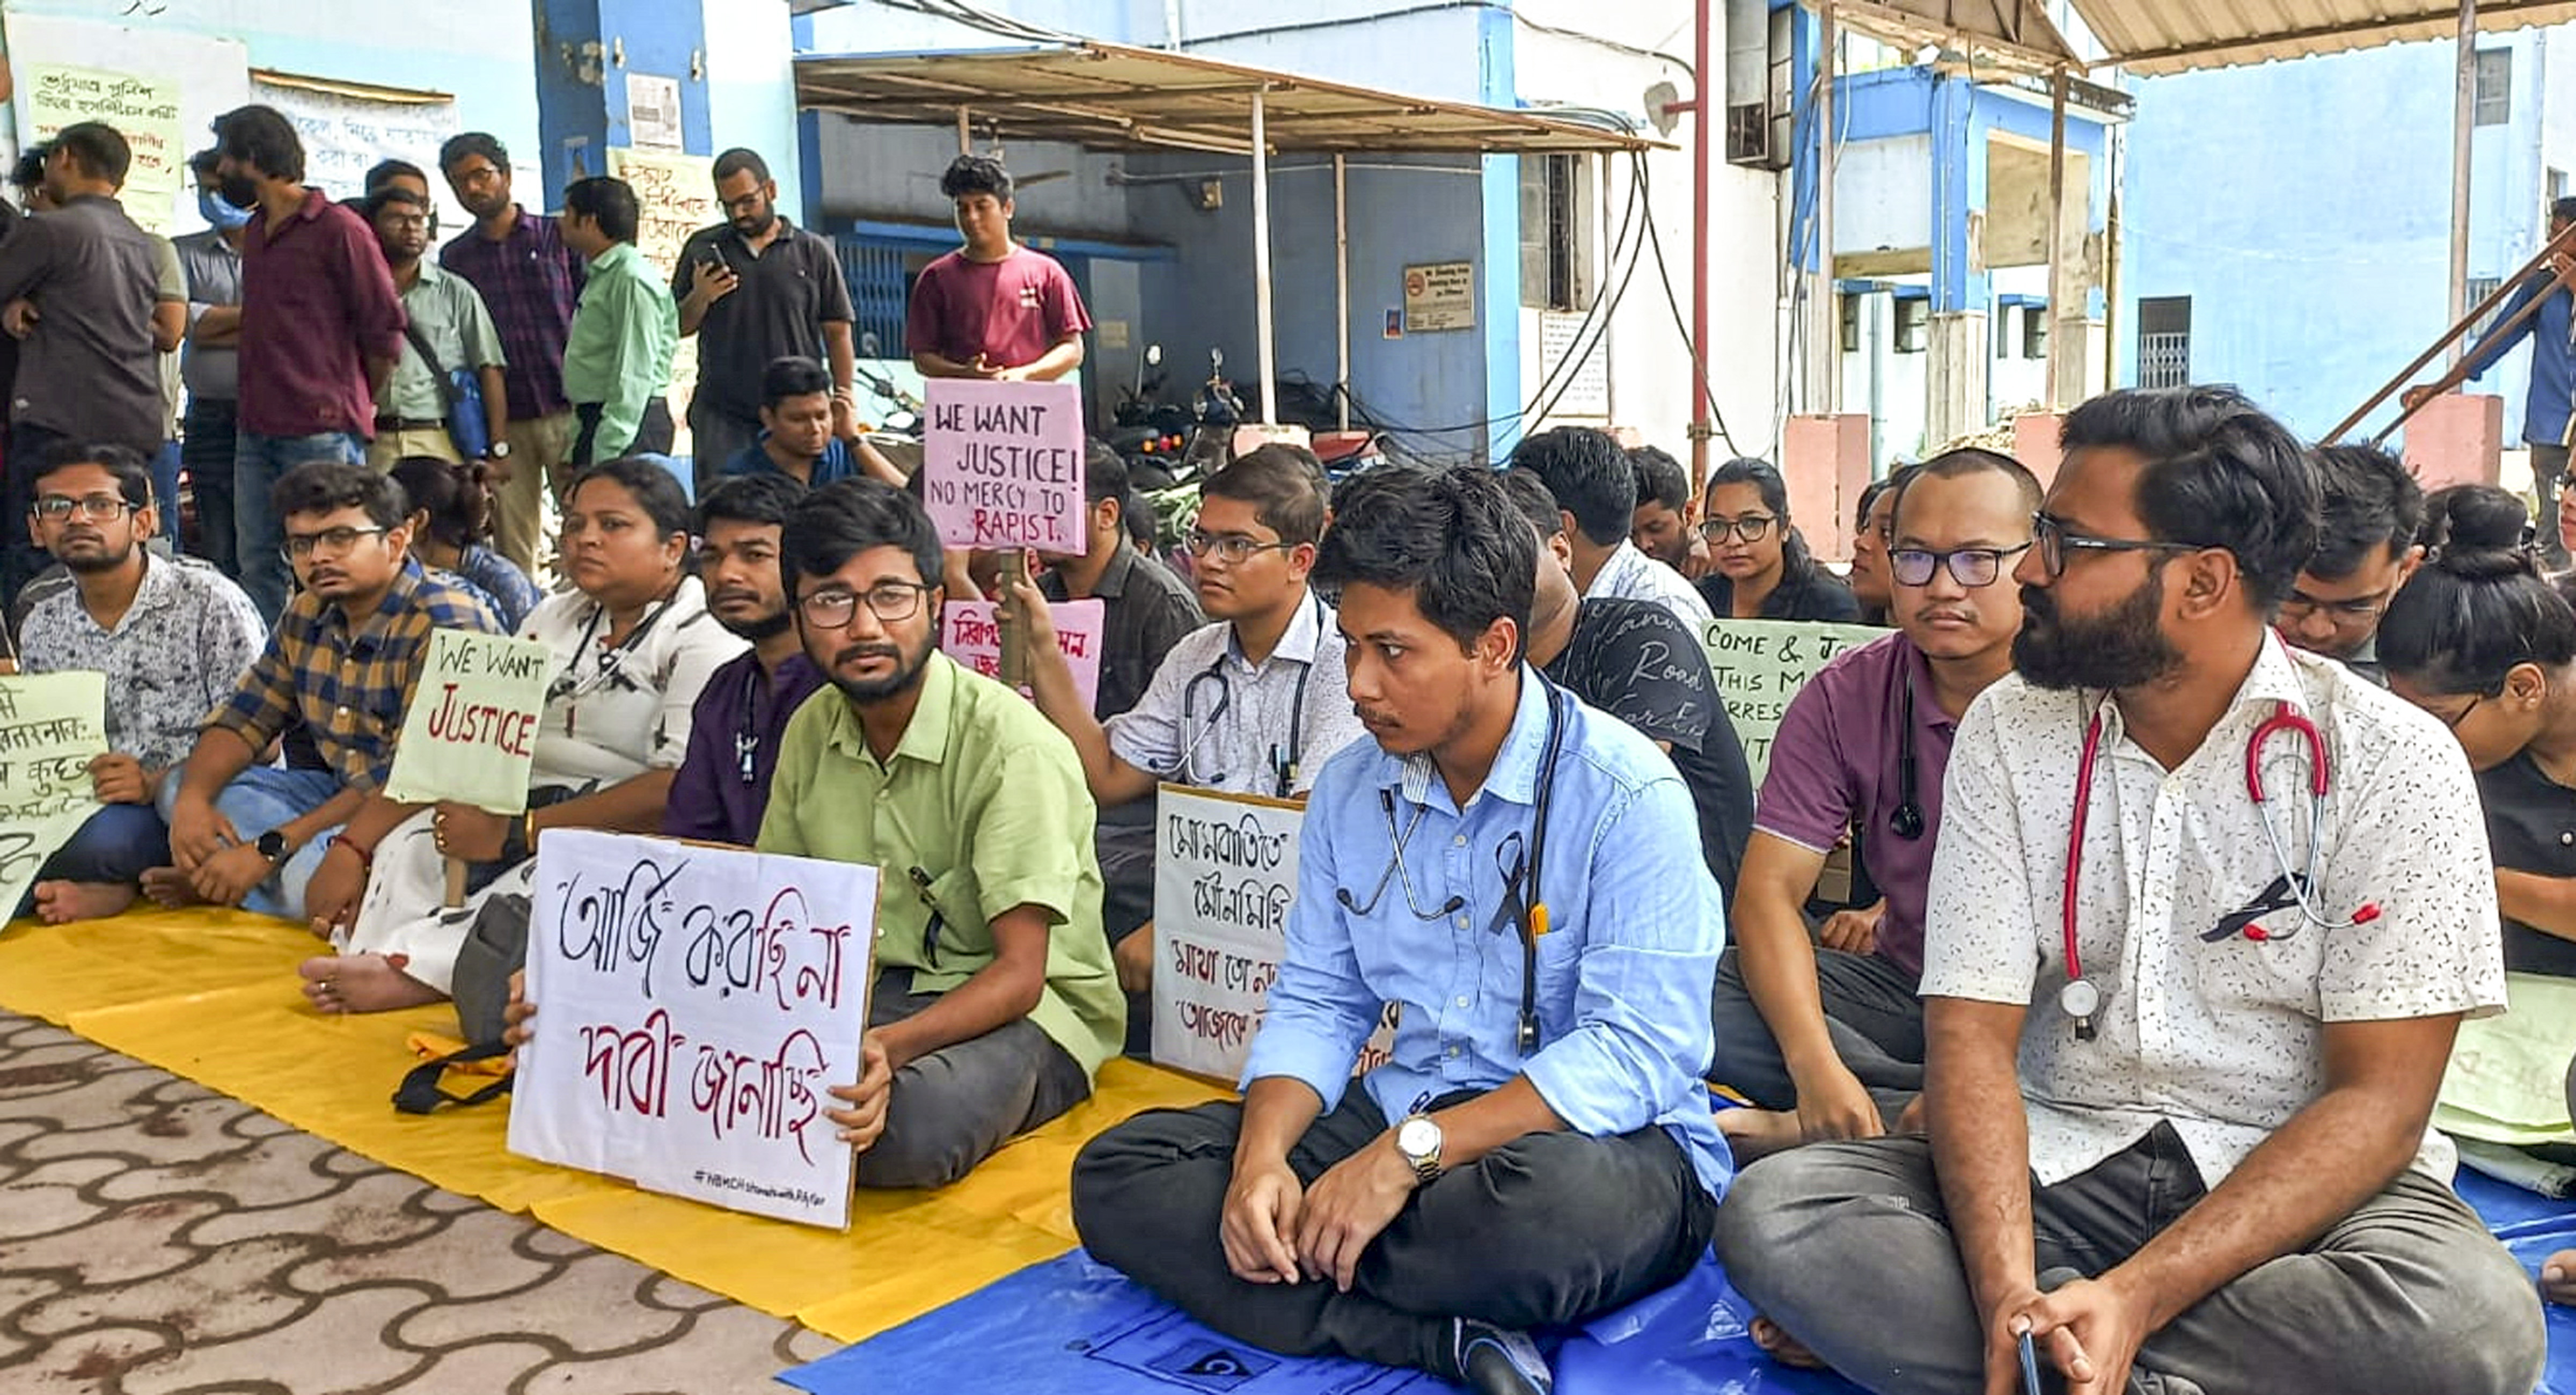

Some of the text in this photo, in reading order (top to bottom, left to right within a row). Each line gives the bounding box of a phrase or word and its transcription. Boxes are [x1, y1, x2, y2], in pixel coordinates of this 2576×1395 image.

[935, 404, 1046, 436] WE WANT
[957, 442, 1077, 492] JUSTICE!
[931, 480, 1065, 514] NO MERCY TO
[974, 509, 1062, 542] RAPIST.
[440, 635, 544, 681] WE WANT
[1627, 641, 1705, 691] Road
[1707, 624, 1768, 654] COME
[1779, 636, 1803, 663] &
[1714, 666, 1763, 691] THIS
[429, 683, 536, 757] JUSTICE
[1169, 813, 1288, 872] মোমবাতিতে
[1192, 870, 1293, 936] মৌনমিছি
[558, 859, 851, 1011] আর্জি করছি না
[1171, 940, 1220, 985] মাথা
[1225, 954, 1253, 991] তো
[580, 1007, 831, 1166] দাবী জানাচ্ছি
